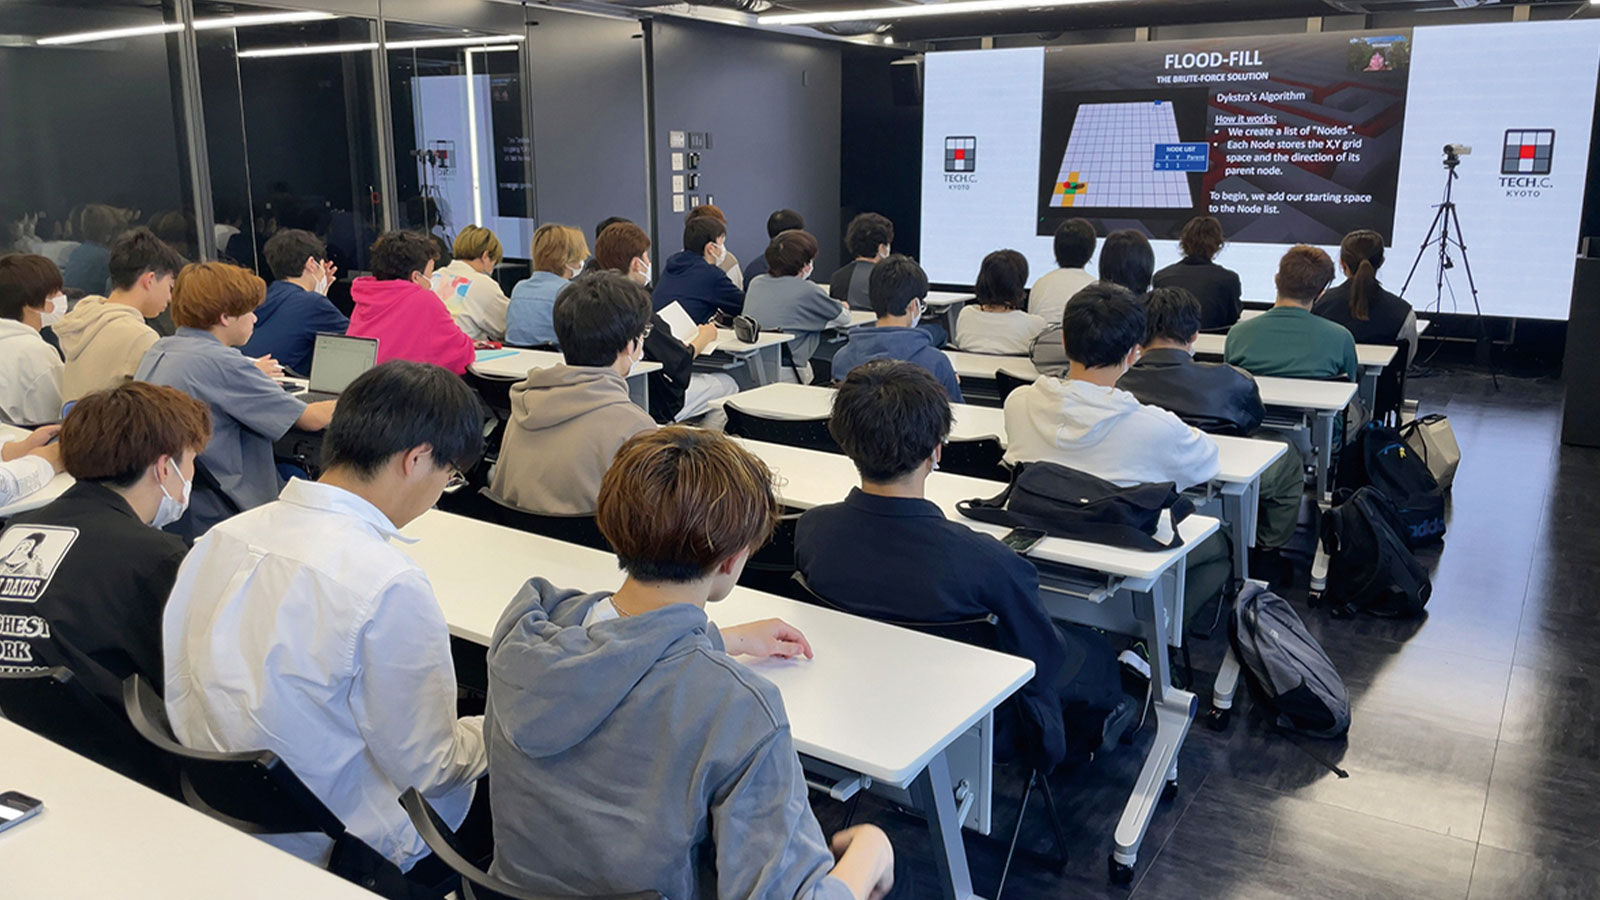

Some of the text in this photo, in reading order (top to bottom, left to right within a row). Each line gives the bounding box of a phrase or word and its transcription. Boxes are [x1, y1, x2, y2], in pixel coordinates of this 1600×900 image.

[1164, 50, 1263, 69] FLOOD-FILL
[1157, 72, 1269, 83] THE BRUTE-FORCE SOLUTION
[1216, 91, 1306, 104] Dykstra's Algorithm
[1215, 113, 1277, 125] How it works:
[1228, 127, 1243, 136] We
[1245, 128, 1274, 136] create
[1275, 128, 1282, 136] a
[1284, 126, 1298, 136] list
[1299, 125, 1311, 136] of
[1227, 140, 1248, 149] Each
[1250, 140, 1276, 149] Node
[1277, 140, 1305, 149] stores
[1308, 139, 1324, 148] the
[1342, 138, 1362, 150] grid
[1226, 151, 1360, 163] space and the direction of its
[1225, 166, 1283, 177] parent node.
[943, 174, 978, 183] TECH.C.
[1498, 177, 1553, 188] TECH.C.
[1210, 191, 1372, 204] To begin, we add our starting space
[1208, 204, 1280, 214] to the Node list.
[1, 578, 40, 597] DAVIS
[0, 614, 50, 638] HEST
[0, 640, 33, 661] RK
